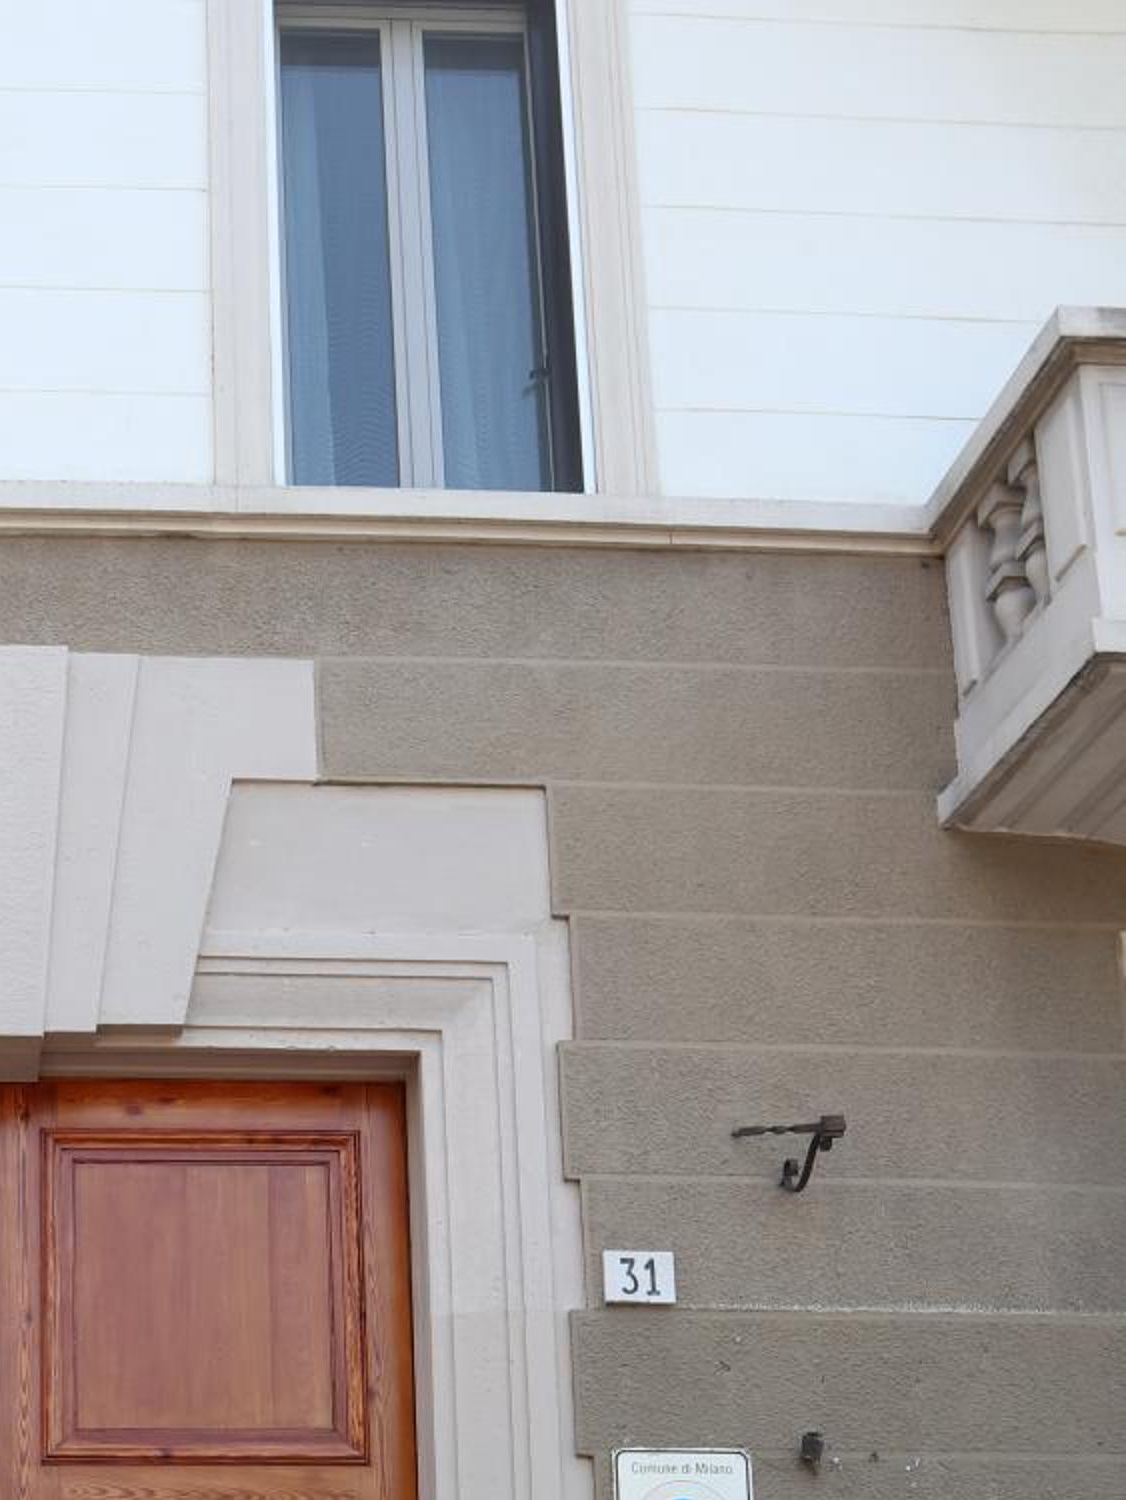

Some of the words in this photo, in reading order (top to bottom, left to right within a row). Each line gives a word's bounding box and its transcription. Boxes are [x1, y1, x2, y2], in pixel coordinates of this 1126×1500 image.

[619, 1257, 661, 1296] 31
[631, 1461, 678, 1475] Comune
[695, 1461, 734, 1475] Milano
